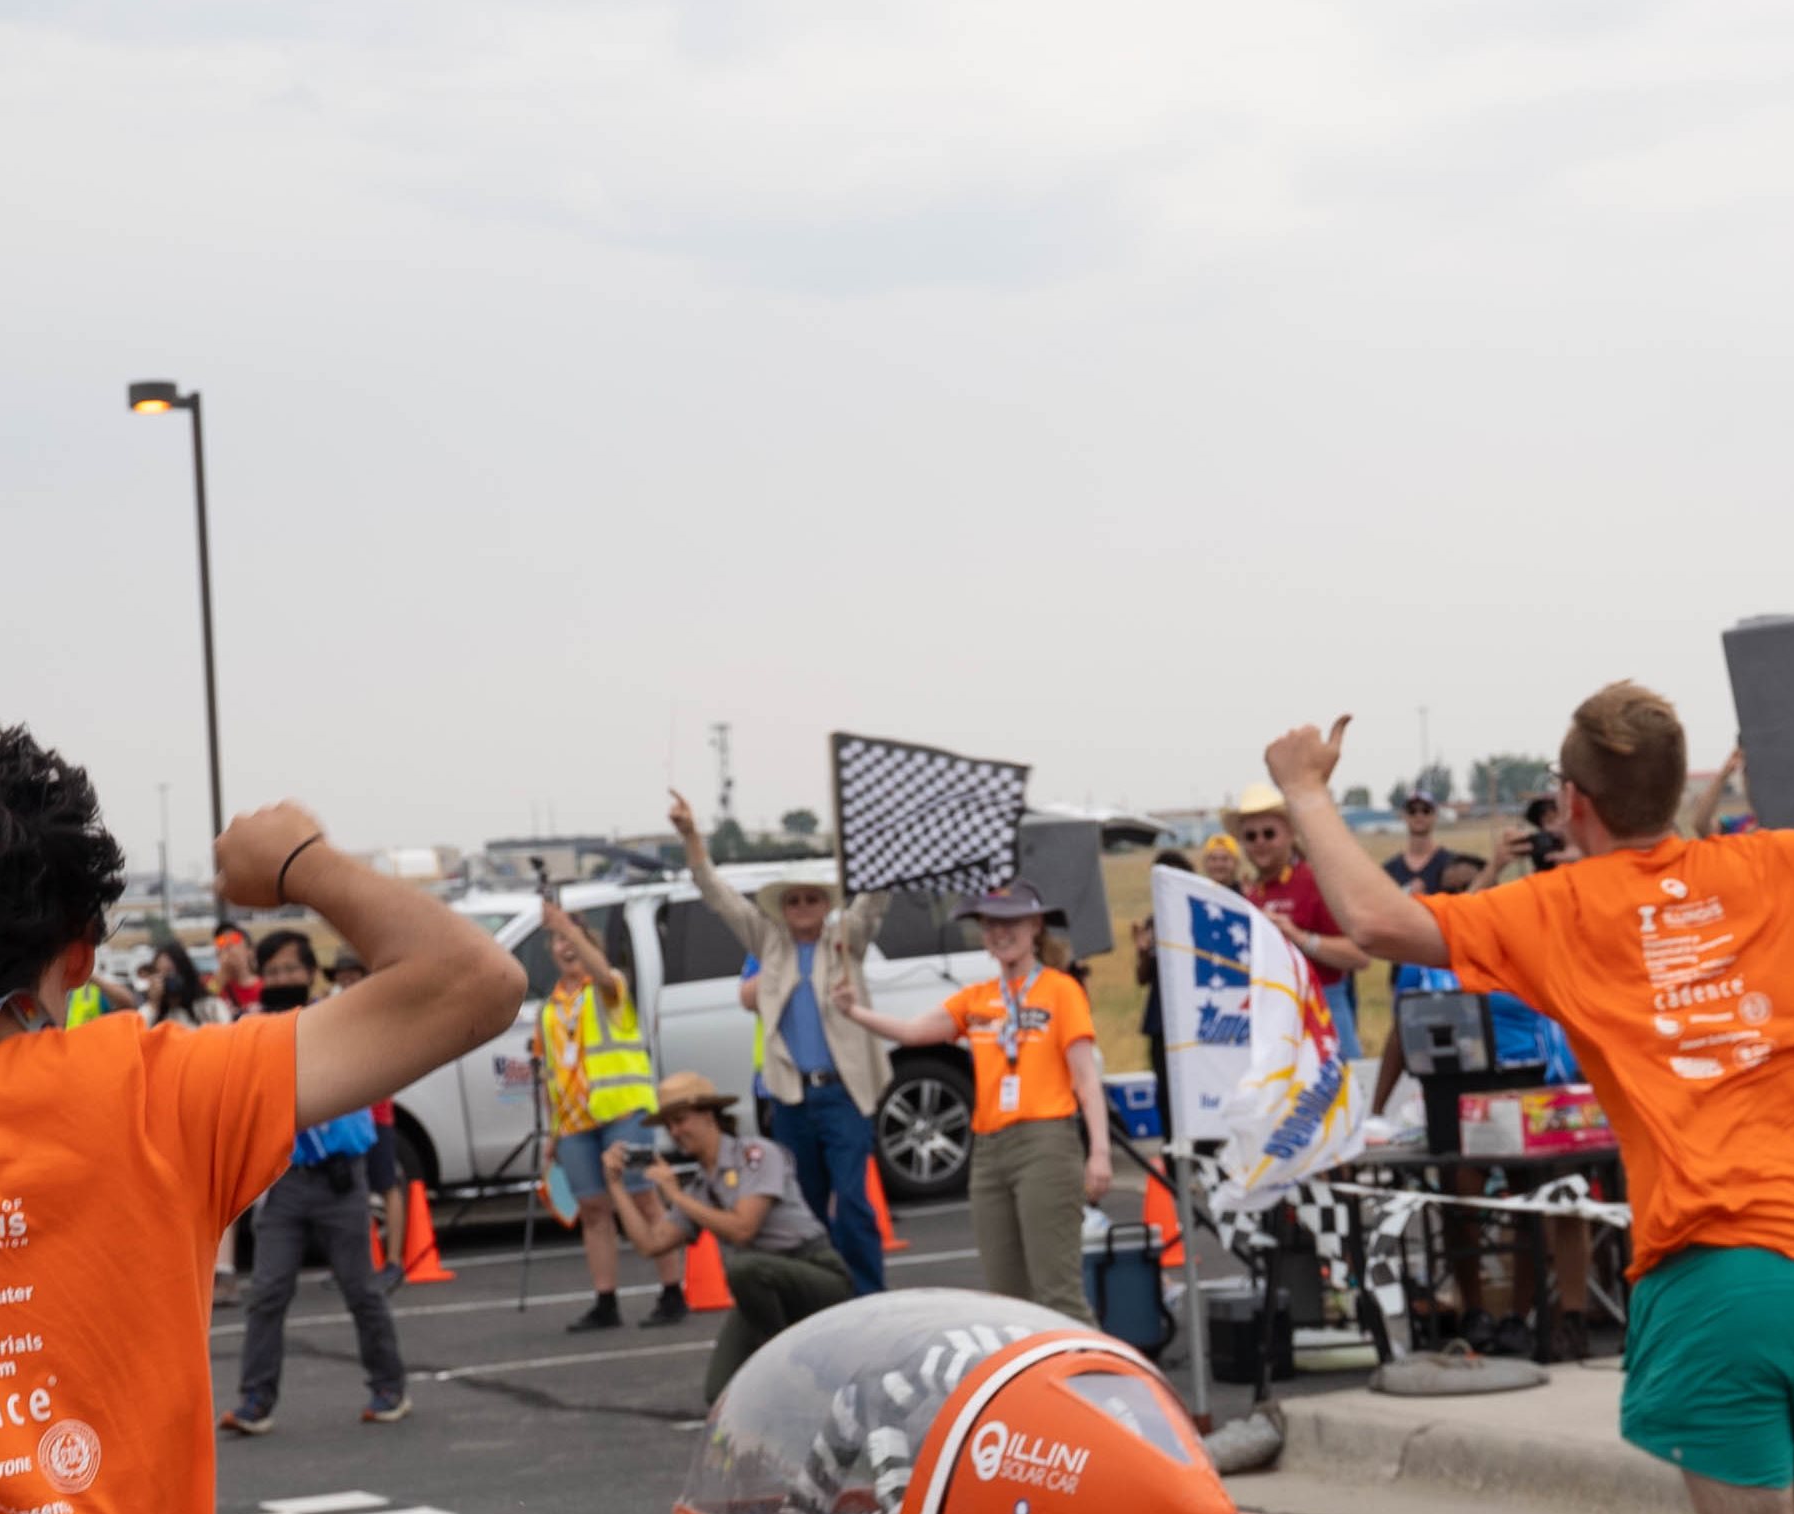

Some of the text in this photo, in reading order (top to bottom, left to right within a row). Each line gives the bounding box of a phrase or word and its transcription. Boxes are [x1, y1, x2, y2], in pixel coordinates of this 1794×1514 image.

[2, 1197, 23, 1213] OF
[1007, 1431, 1090, 1474] ILLINI
[1000, 1458, 1079, 1496] SOLAR CAR
